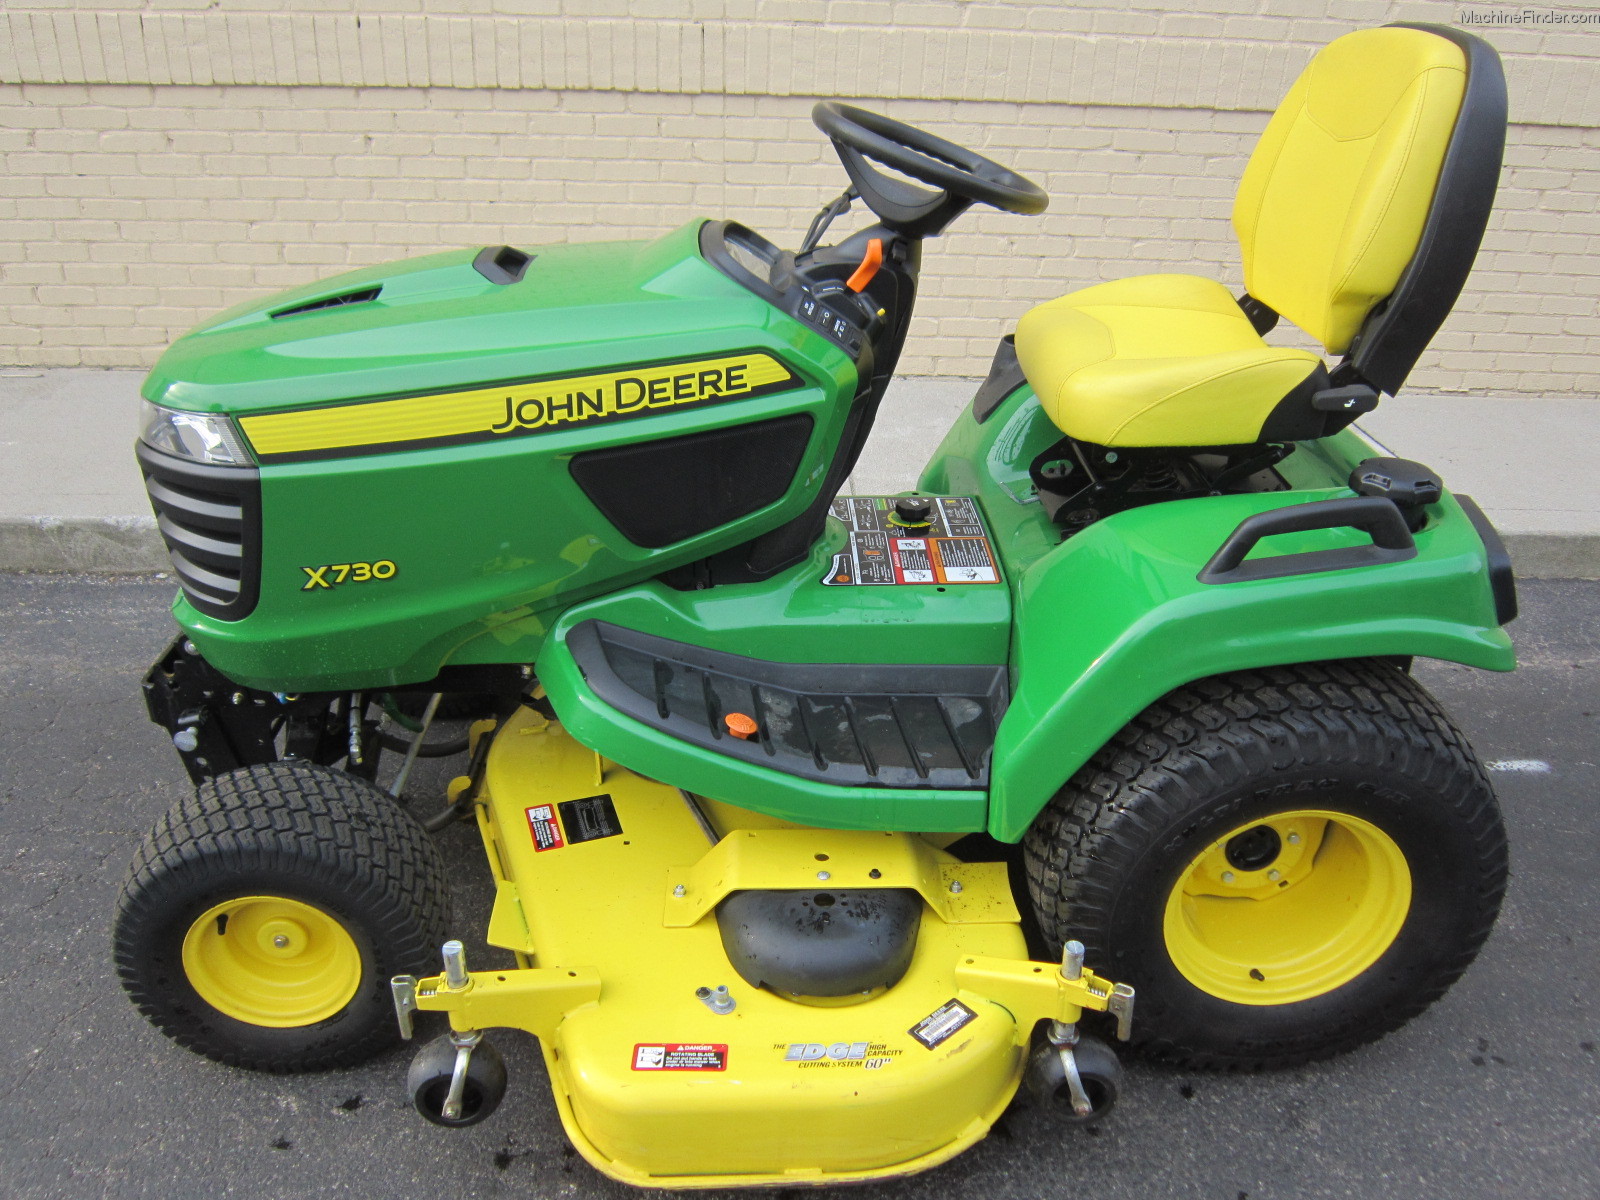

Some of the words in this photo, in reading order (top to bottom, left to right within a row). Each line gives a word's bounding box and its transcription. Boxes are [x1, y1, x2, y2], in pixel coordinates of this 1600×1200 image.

[491, 388, 604, 430] JOHN
[614, 363, 748, 410] DEERE
[301, 560, 397, 590] X730
[784, 1042, 869, 1061] EDGE
[867, 1049, 904, 1057] CAPACITY
[798, 1061, 830, 1069] CUTTING
[831, 1060, 863, 1068] SYSTEM
[864, 1058, 892, 1070] 60"
